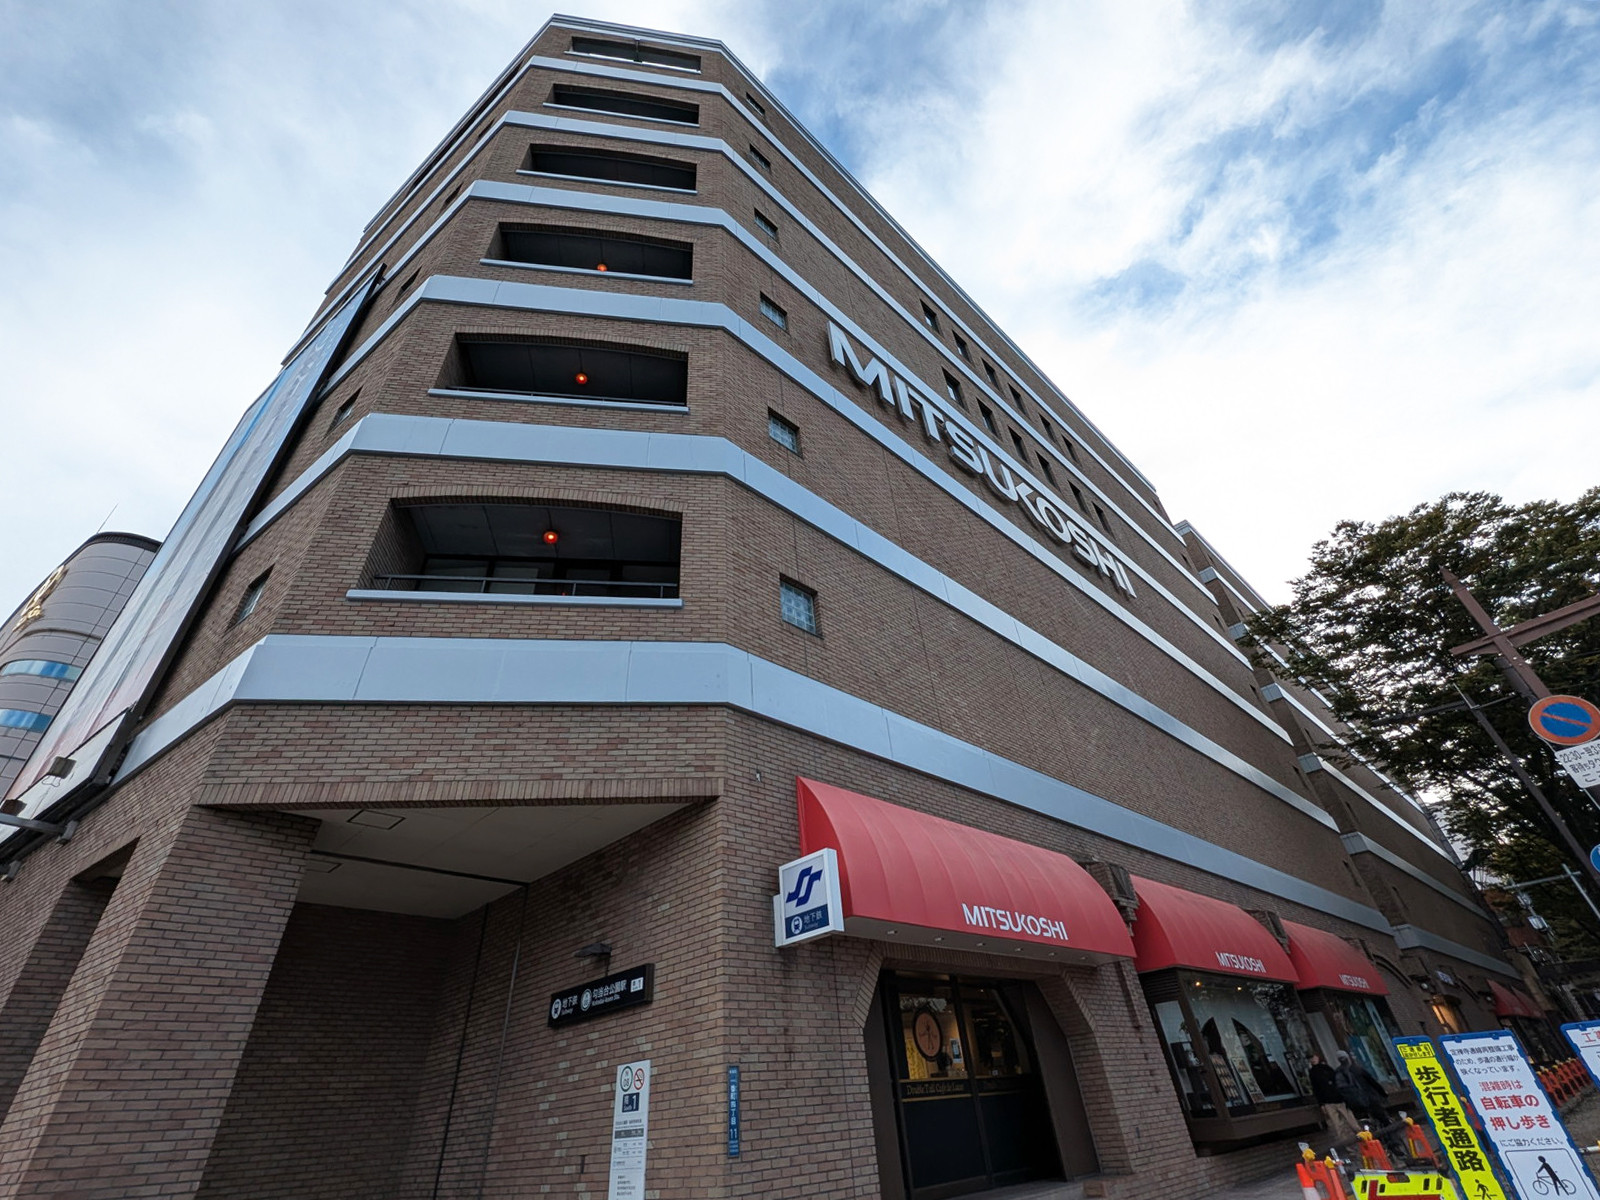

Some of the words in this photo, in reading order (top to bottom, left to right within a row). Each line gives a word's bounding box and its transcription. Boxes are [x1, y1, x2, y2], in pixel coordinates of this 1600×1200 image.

[826, 320, 1137, 599] MITSUKOSHI
[961, 903, 1069, 940] MITSUKOSHI
[1215, 951, 1267, 973] MITSUKOSHI
[1338, 974, 1370, 989] MITSUKOSHI
[1460, 1065, 1520, 1075] 狭くなっています。
[1479, 1080, 1523, 1091] 混雑時は
[632, 1094, 637, 1110] 1
[1480, 1094, 1539, 1110] 自転車の
[1415, 1066, 1485, 1172] 歩行者通路
[1490, 1114, 1550, 1131] 押し歩き
[1500, 1137, 1564, 1147] にご協力ください。
